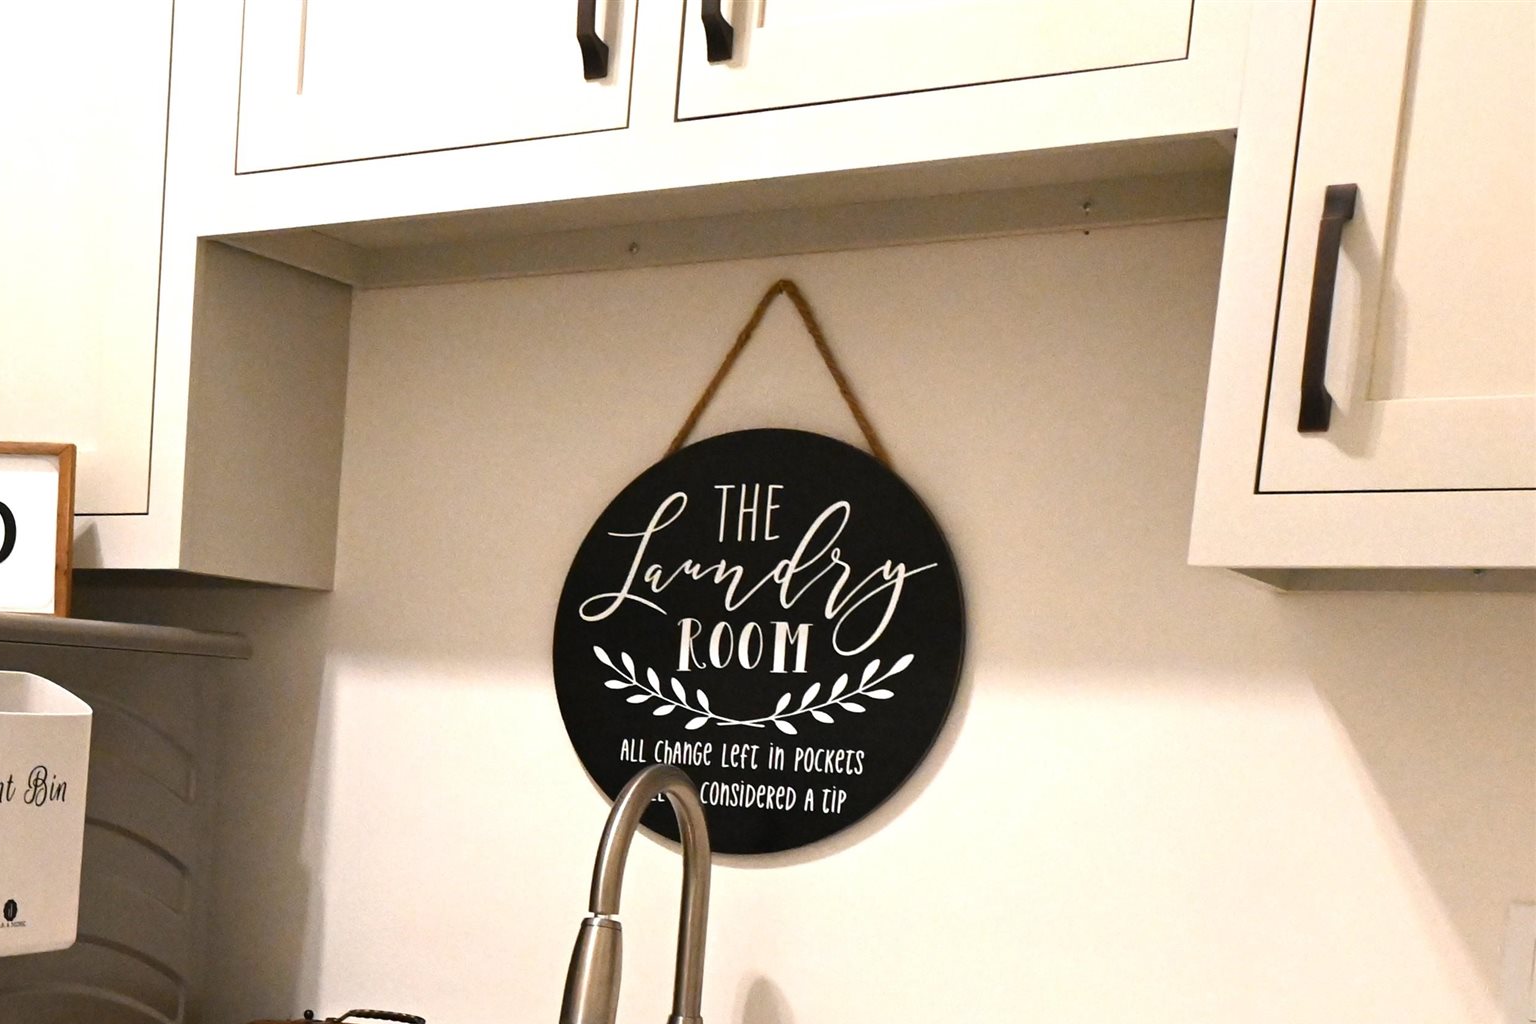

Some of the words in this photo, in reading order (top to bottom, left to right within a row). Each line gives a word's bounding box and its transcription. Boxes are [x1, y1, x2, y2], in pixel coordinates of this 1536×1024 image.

[714, 482, 784, 543] THE
[579, 491, 938, 657] Laundry
[676, 617, 814, 674] ROOM
[620, 738, 647, 764] ALL
[768, 742, 785, 772] in
[23, 765, 67, 808] Bin
[804, 786, 815, 813] A
